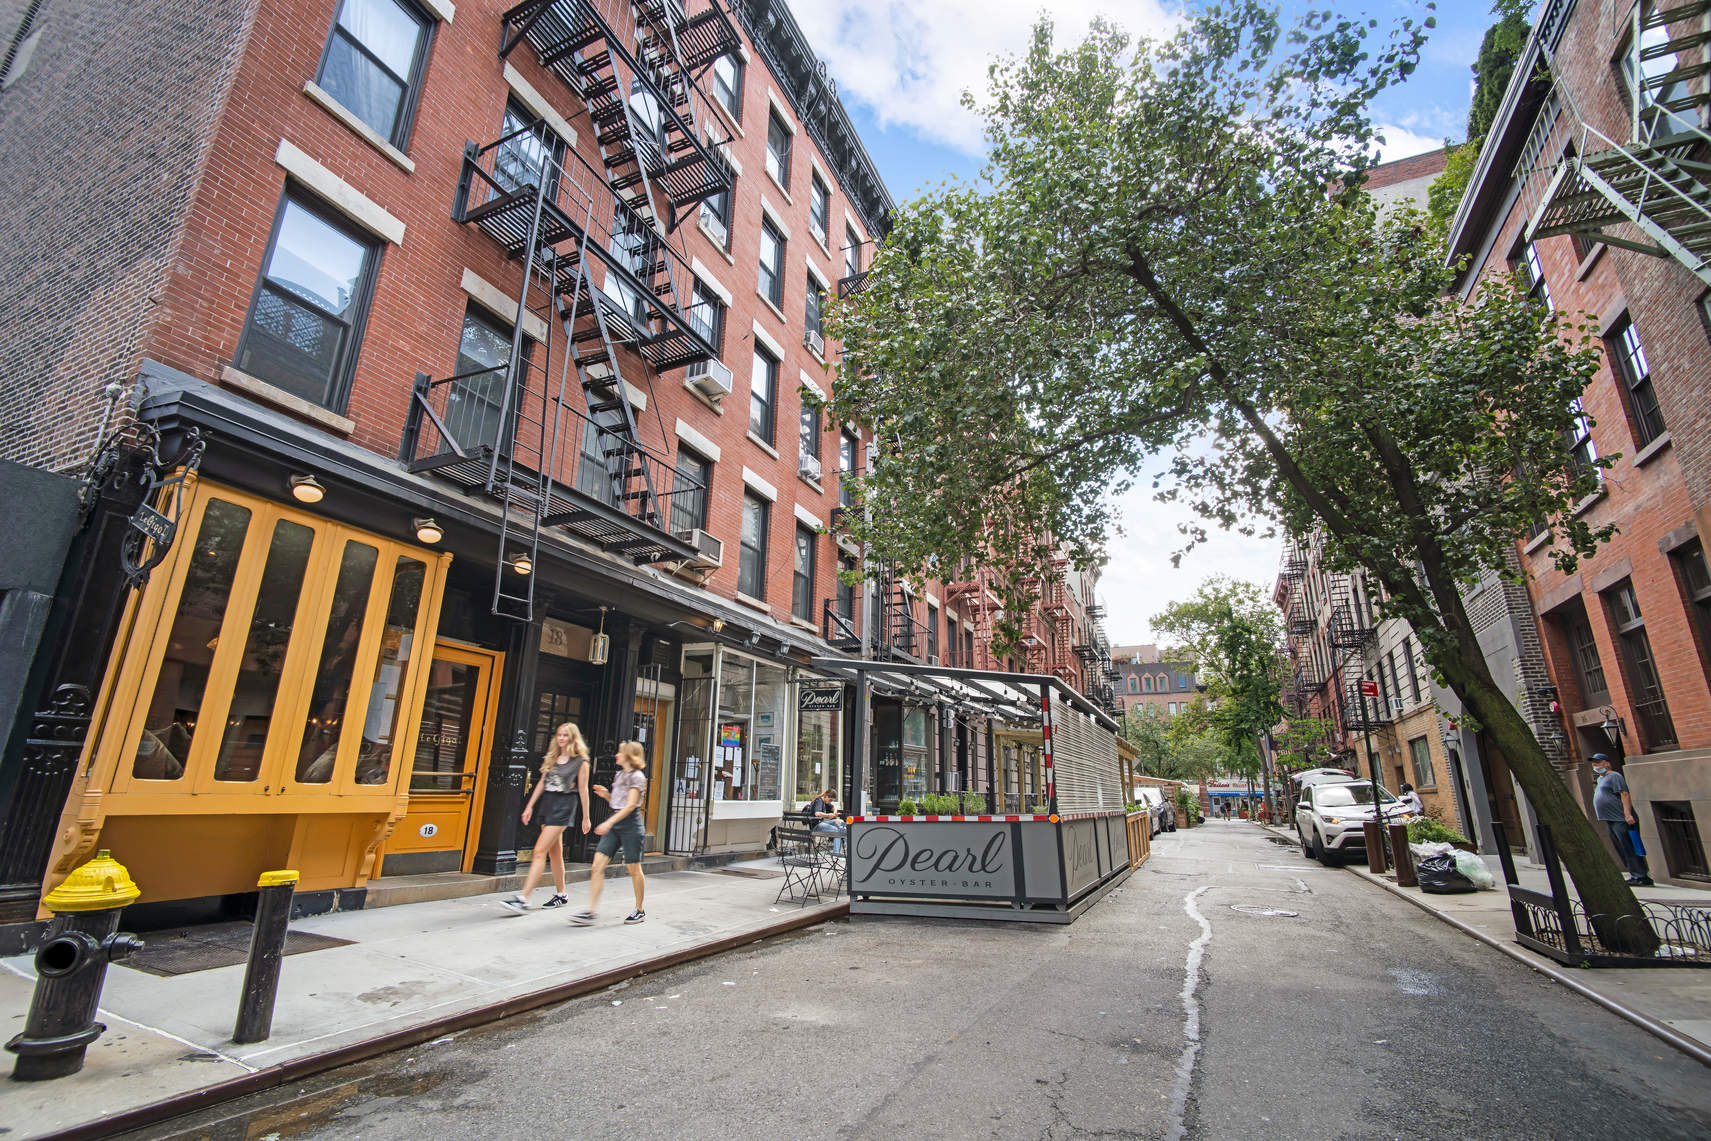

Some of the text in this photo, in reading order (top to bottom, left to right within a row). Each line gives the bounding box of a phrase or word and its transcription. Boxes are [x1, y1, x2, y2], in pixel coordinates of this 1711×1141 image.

[549, 629, 563, 646] 18
[800, 690, 840, 708] Pearl
[424, 826, 434, 835] 18
[855, 826, 1006, 883] Pearl
[888, 878, 993, 888] OYSTER BAR
